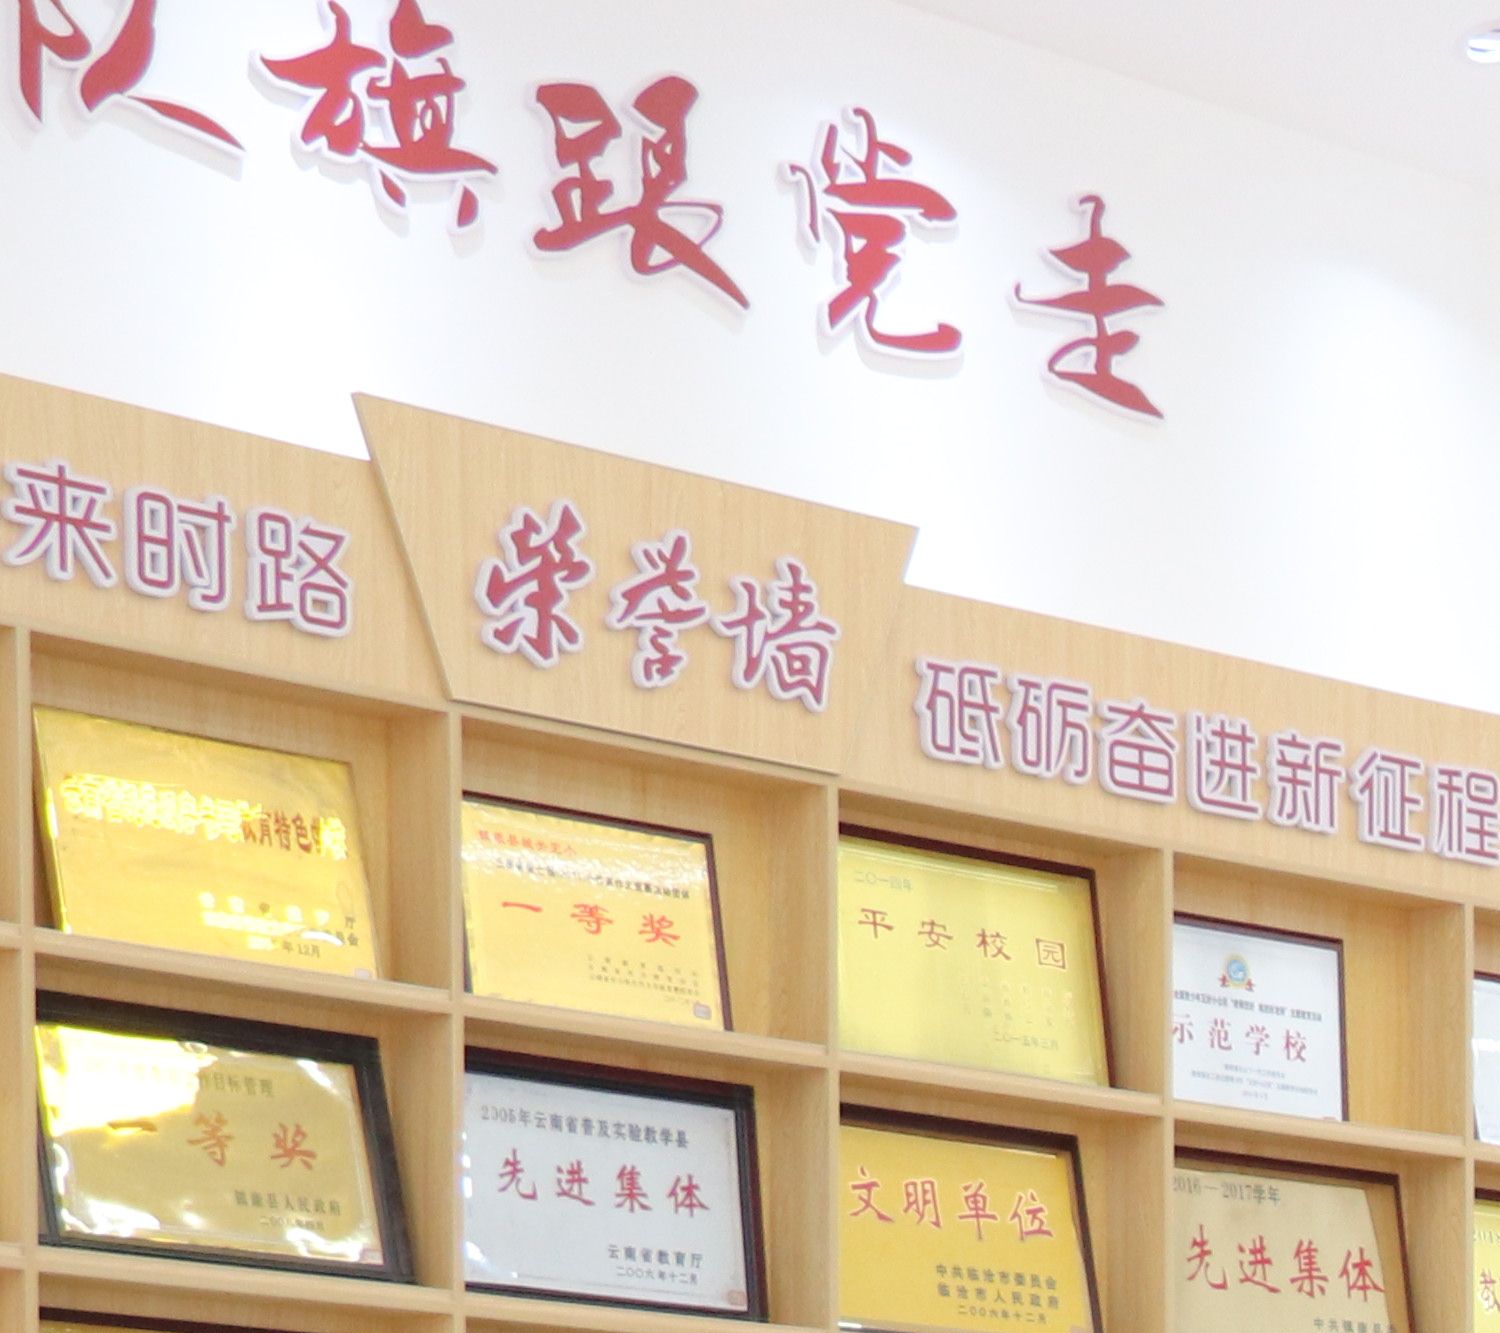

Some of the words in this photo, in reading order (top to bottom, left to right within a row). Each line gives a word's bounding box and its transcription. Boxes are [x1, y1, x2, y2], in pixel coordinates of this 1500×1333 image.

[7, 464, 352, 637] 来时路
[477, 504, 838, 708] 荣誉墙
[921, 661, 1500, 862] 砥砺奋进新征程
[502, 902, 680, 947] 一等奖
[858, 908, 1066, 969] 平安校园
[1172, 1014, 1306, 1062] 示范学校
[498, 1148, 711, 1218] 先进集体
[849, 1166, 1054, 1242] 文明单位
[607, 1244, 704, 1269] 云南省教育厅
[1187, 1224, 1386, 1302] 先进集体
